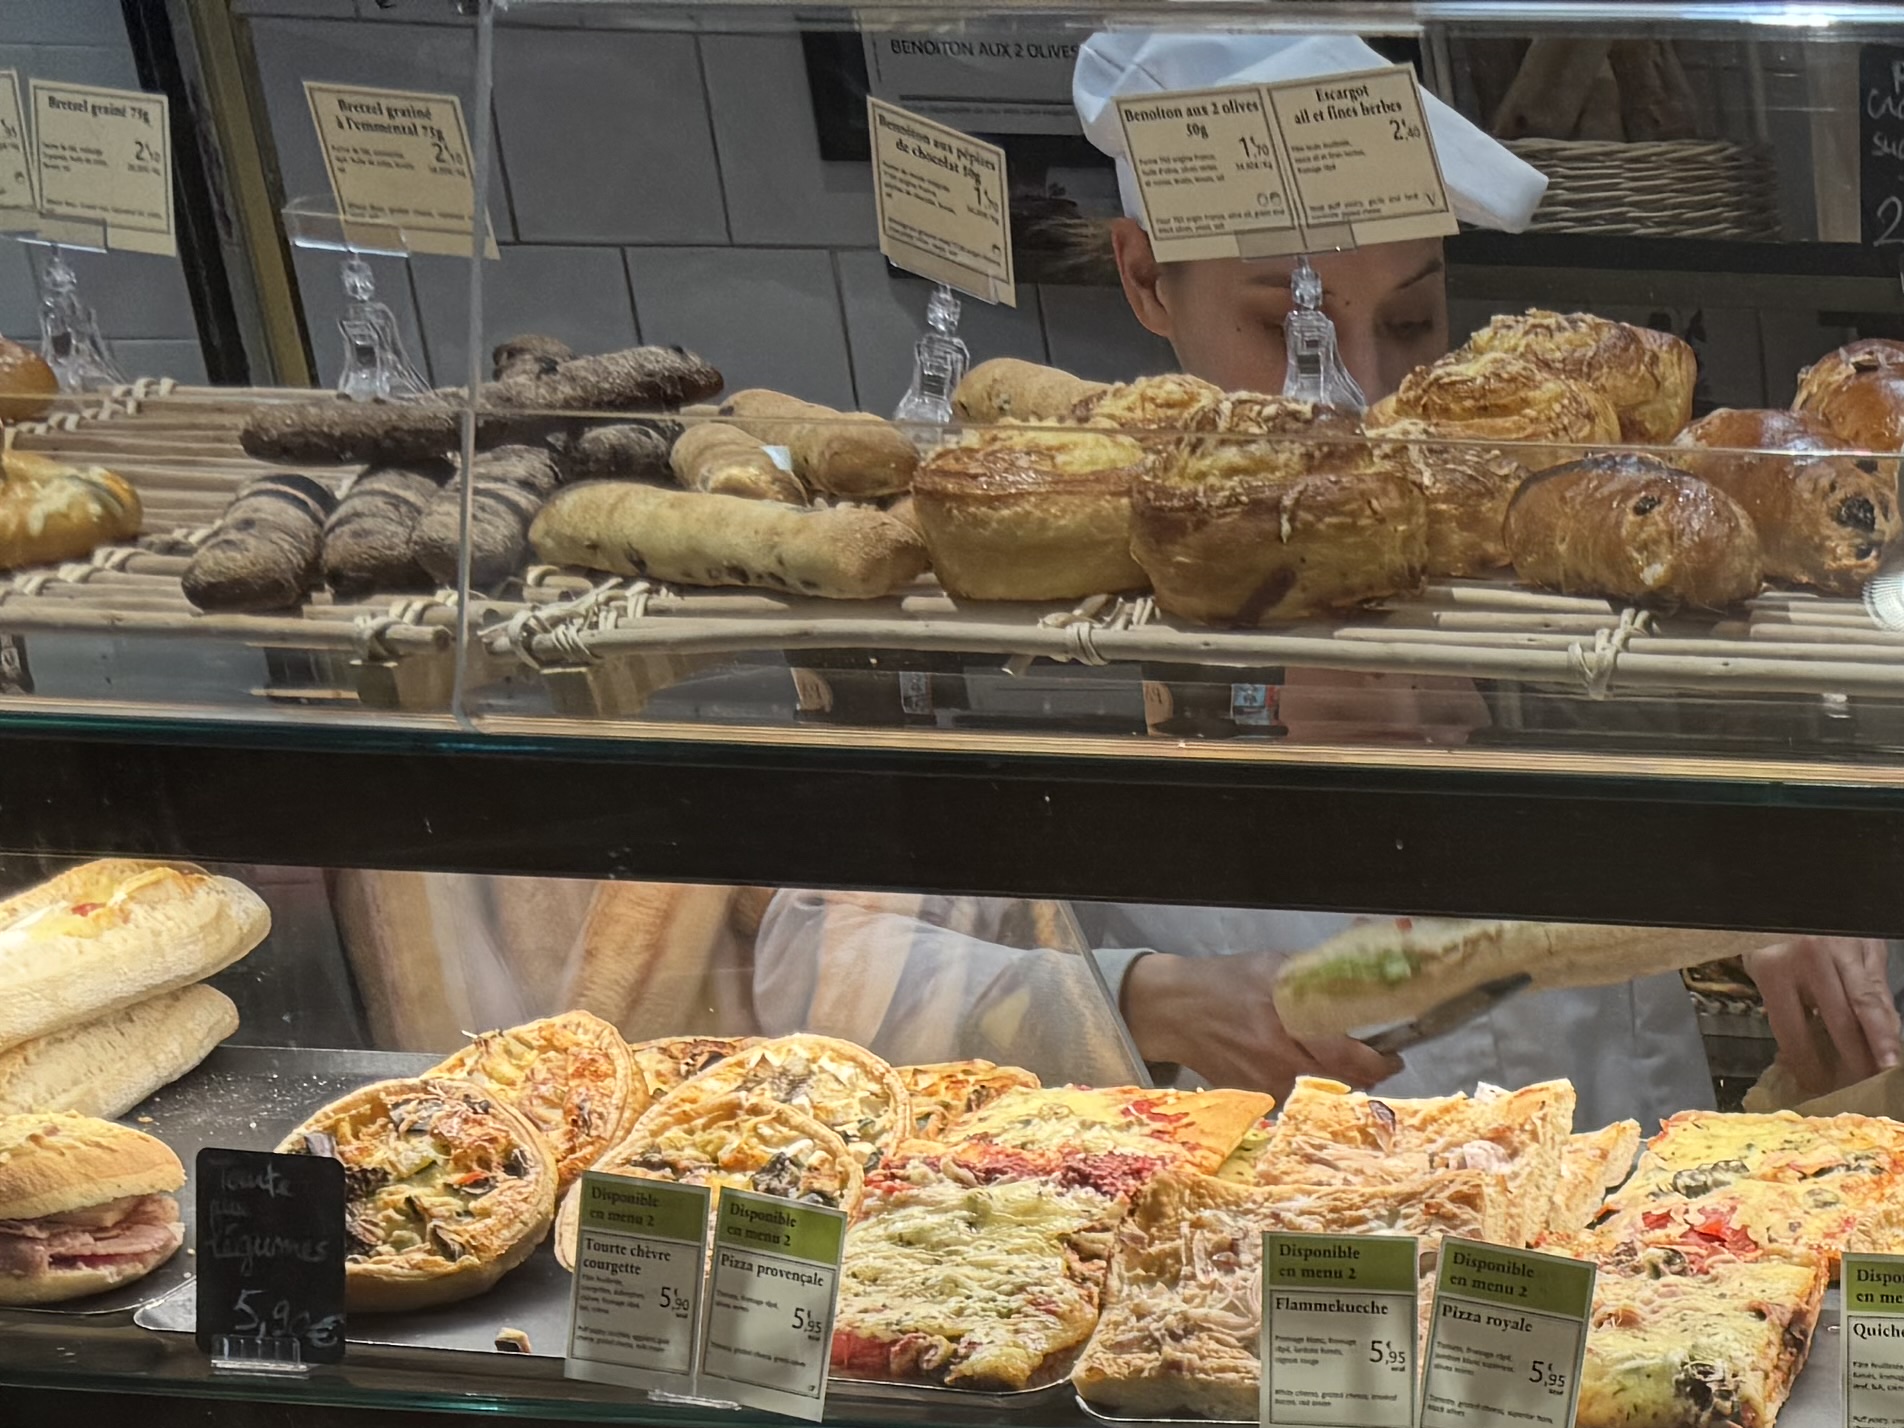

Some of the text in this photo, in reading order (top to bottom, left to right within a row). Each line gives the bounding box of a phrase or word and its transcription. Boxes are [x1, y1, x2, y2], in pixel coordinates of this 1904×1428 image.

[1278, 1242, 1361, 1262] Disponible
[719, 1252, 827, 1288] Pizza provençale
[1277, 1266, 1357, 1280] en menu 2
[1274, 1295, 1389, 1316] Flammekueche
[1440, 1302, 1533, 1333] Pizza royale
